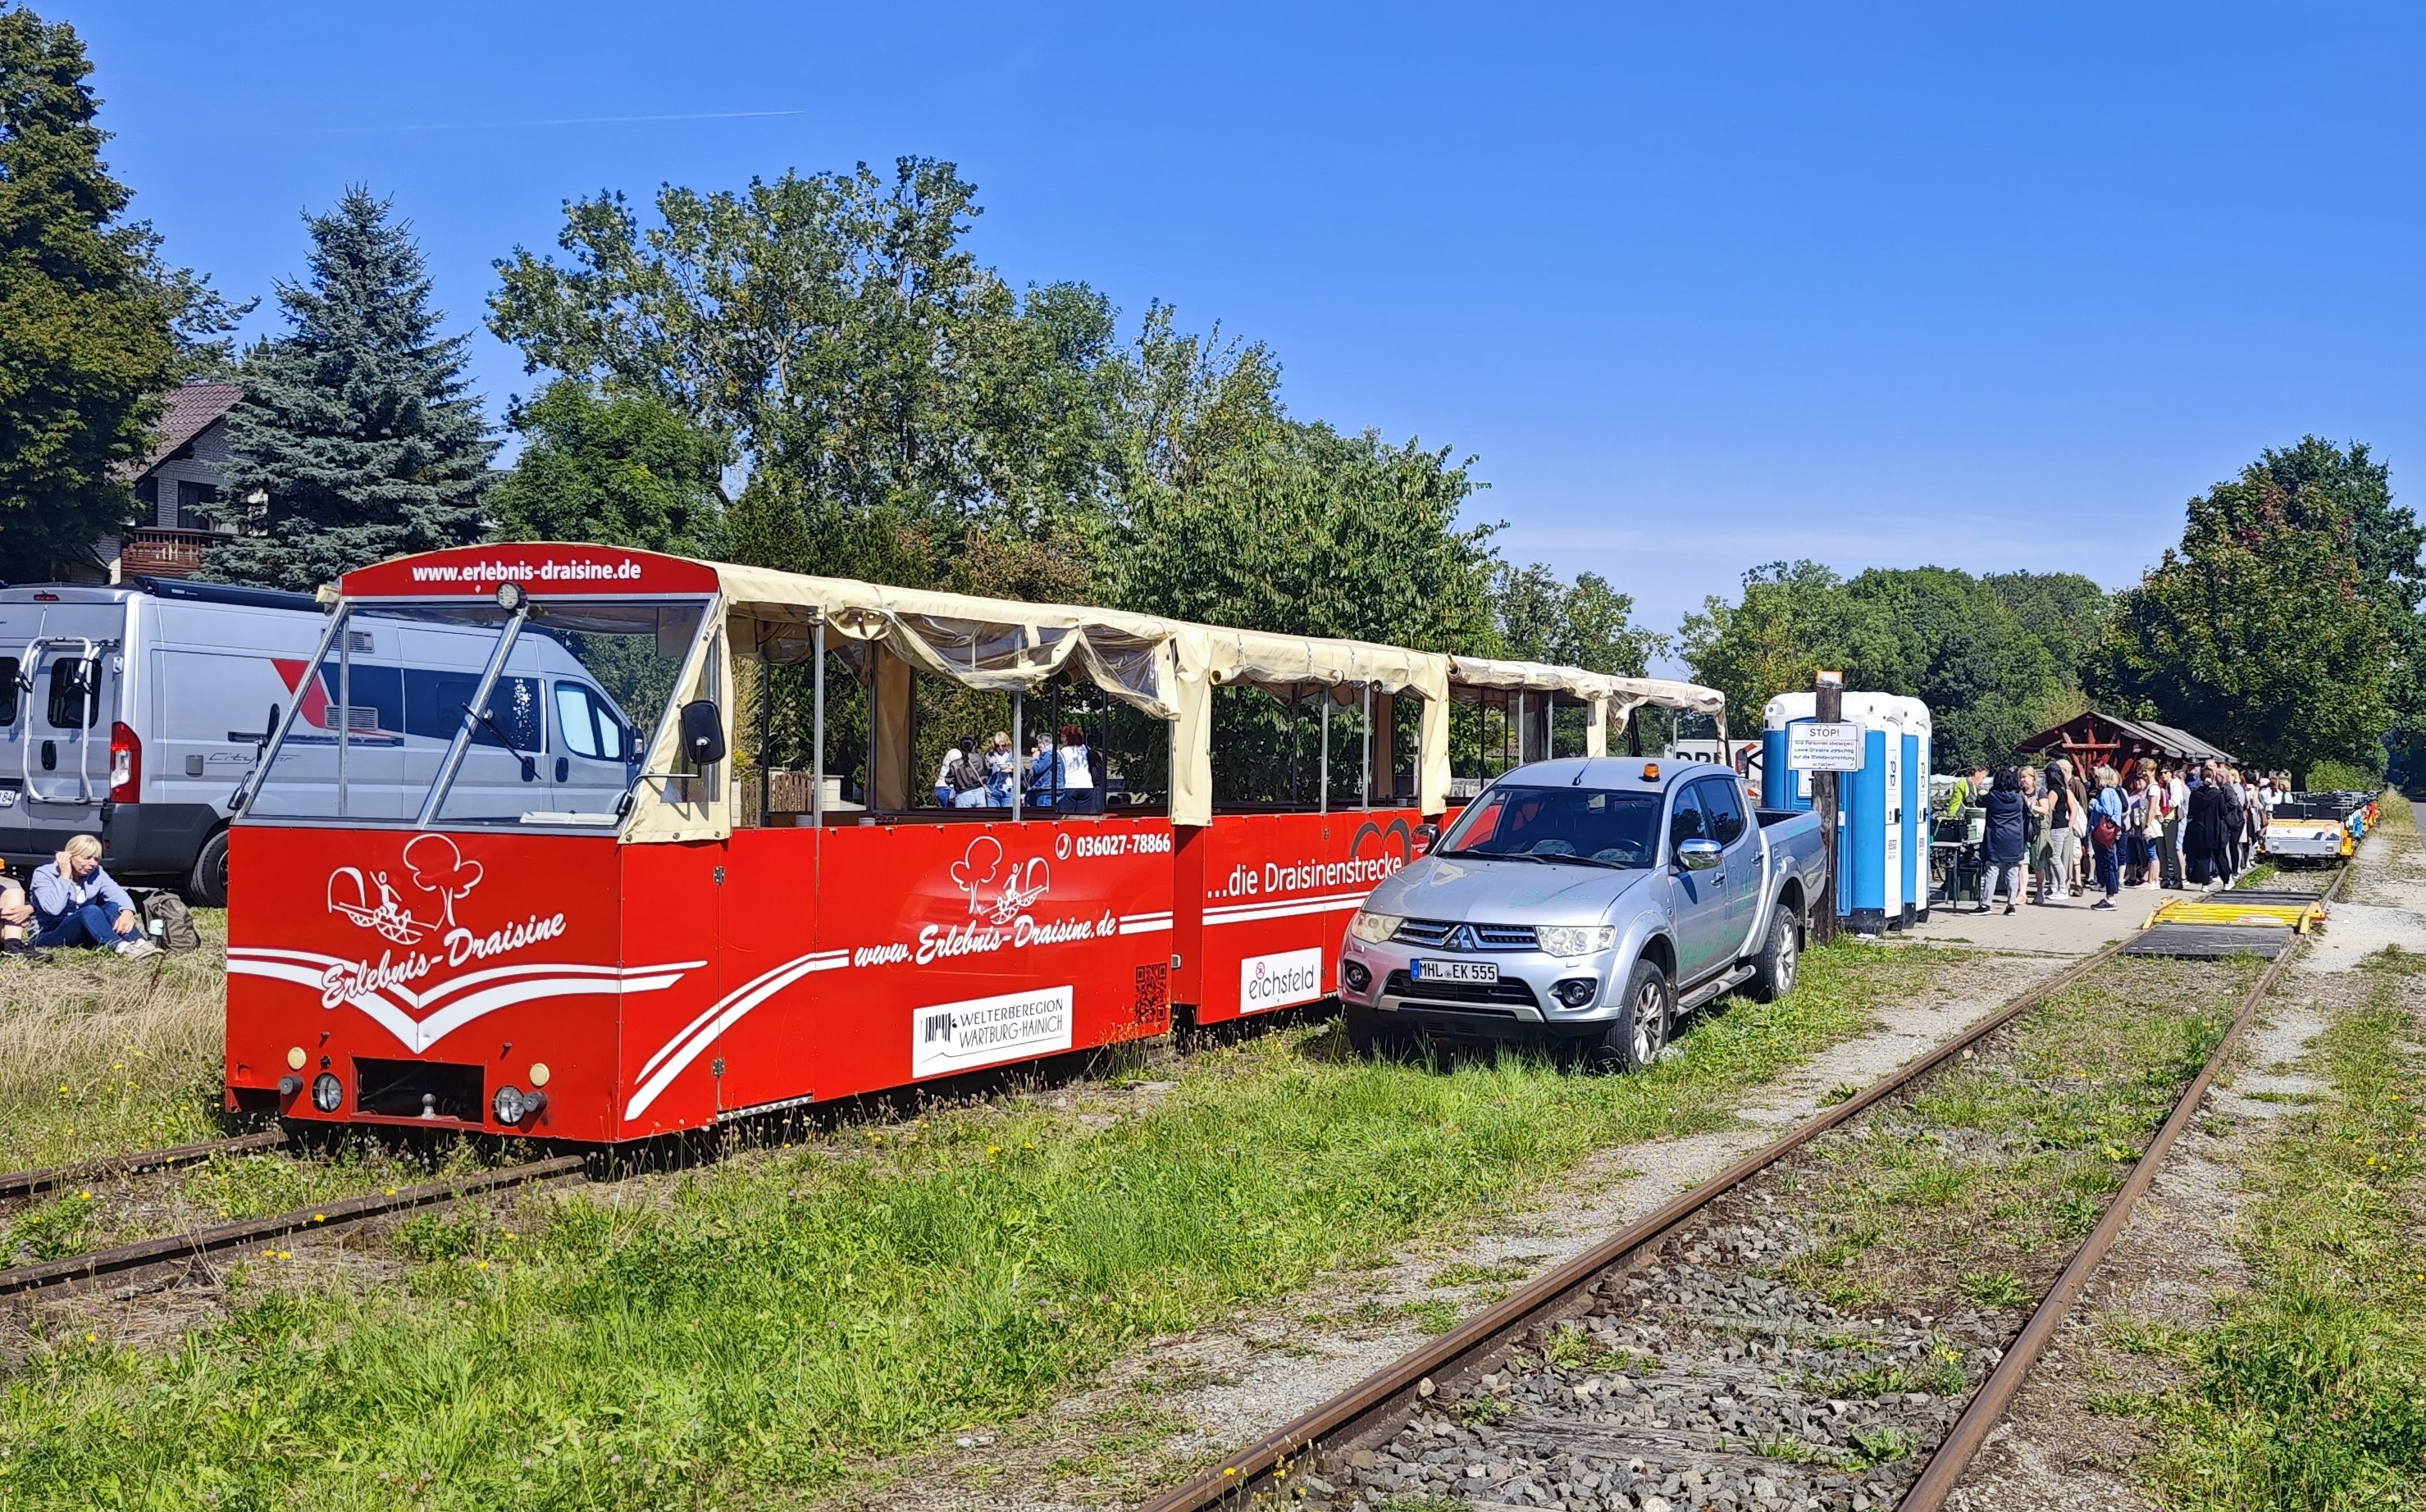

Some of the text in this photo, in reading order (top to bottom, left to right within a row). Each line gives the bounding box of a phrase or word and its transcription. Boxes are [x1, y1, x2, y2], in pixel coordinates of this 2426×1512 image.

[413, 558, 642, 582] www.erlebnis-draisine.de
[1809, 728, 1840, 737] STOP!
[1076, 832, 1171, 858] 036027-78866
[1264, 850, 1403, 893] Draisinenstrecke
[854, 909, 1117, 968] www.Erlebnis-Draisine.de
[321, 912, 568, 1009] Erlebnis-Draisine
[1420, 961, 1496, 981] MHL EK 555
[1248, 964, 1315, 1000] eichsfeld
[960, 997, 1064, 1026] WELTERBEREGION
